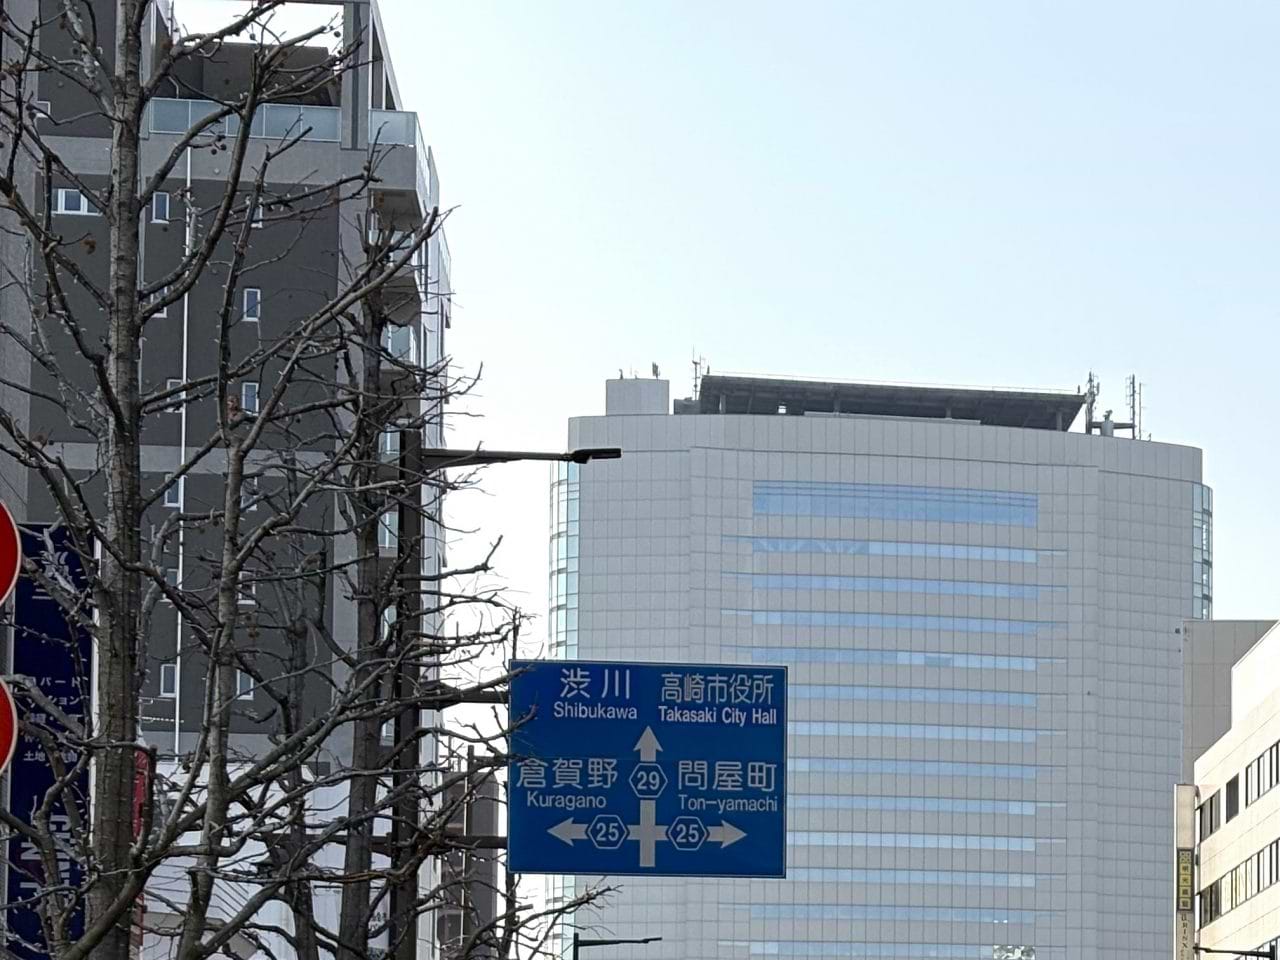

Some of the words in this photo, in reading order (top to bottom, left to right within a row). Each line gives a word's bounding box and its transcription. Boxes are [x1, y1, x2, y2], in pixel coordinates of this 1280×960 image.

[560, 668, 630, 699] 渋川
[661, 671, 774, 704] 高崎市役所
[553, 701, 637, 719] Shibukawa
[658, 706, 716, 723] Takasaki
[721, 707, 747, 727] City
[752, 708, 777, 725] Hall
[516, 758, 617, 789] 倉賀野
[636, 771, 660, 790] 29
[678, 760, 777, 791] 問屋町
[526, 790, 606, 811] Kuragano
[596, 823, 619, 842] 25
[675, 823, 699, 843] 25
